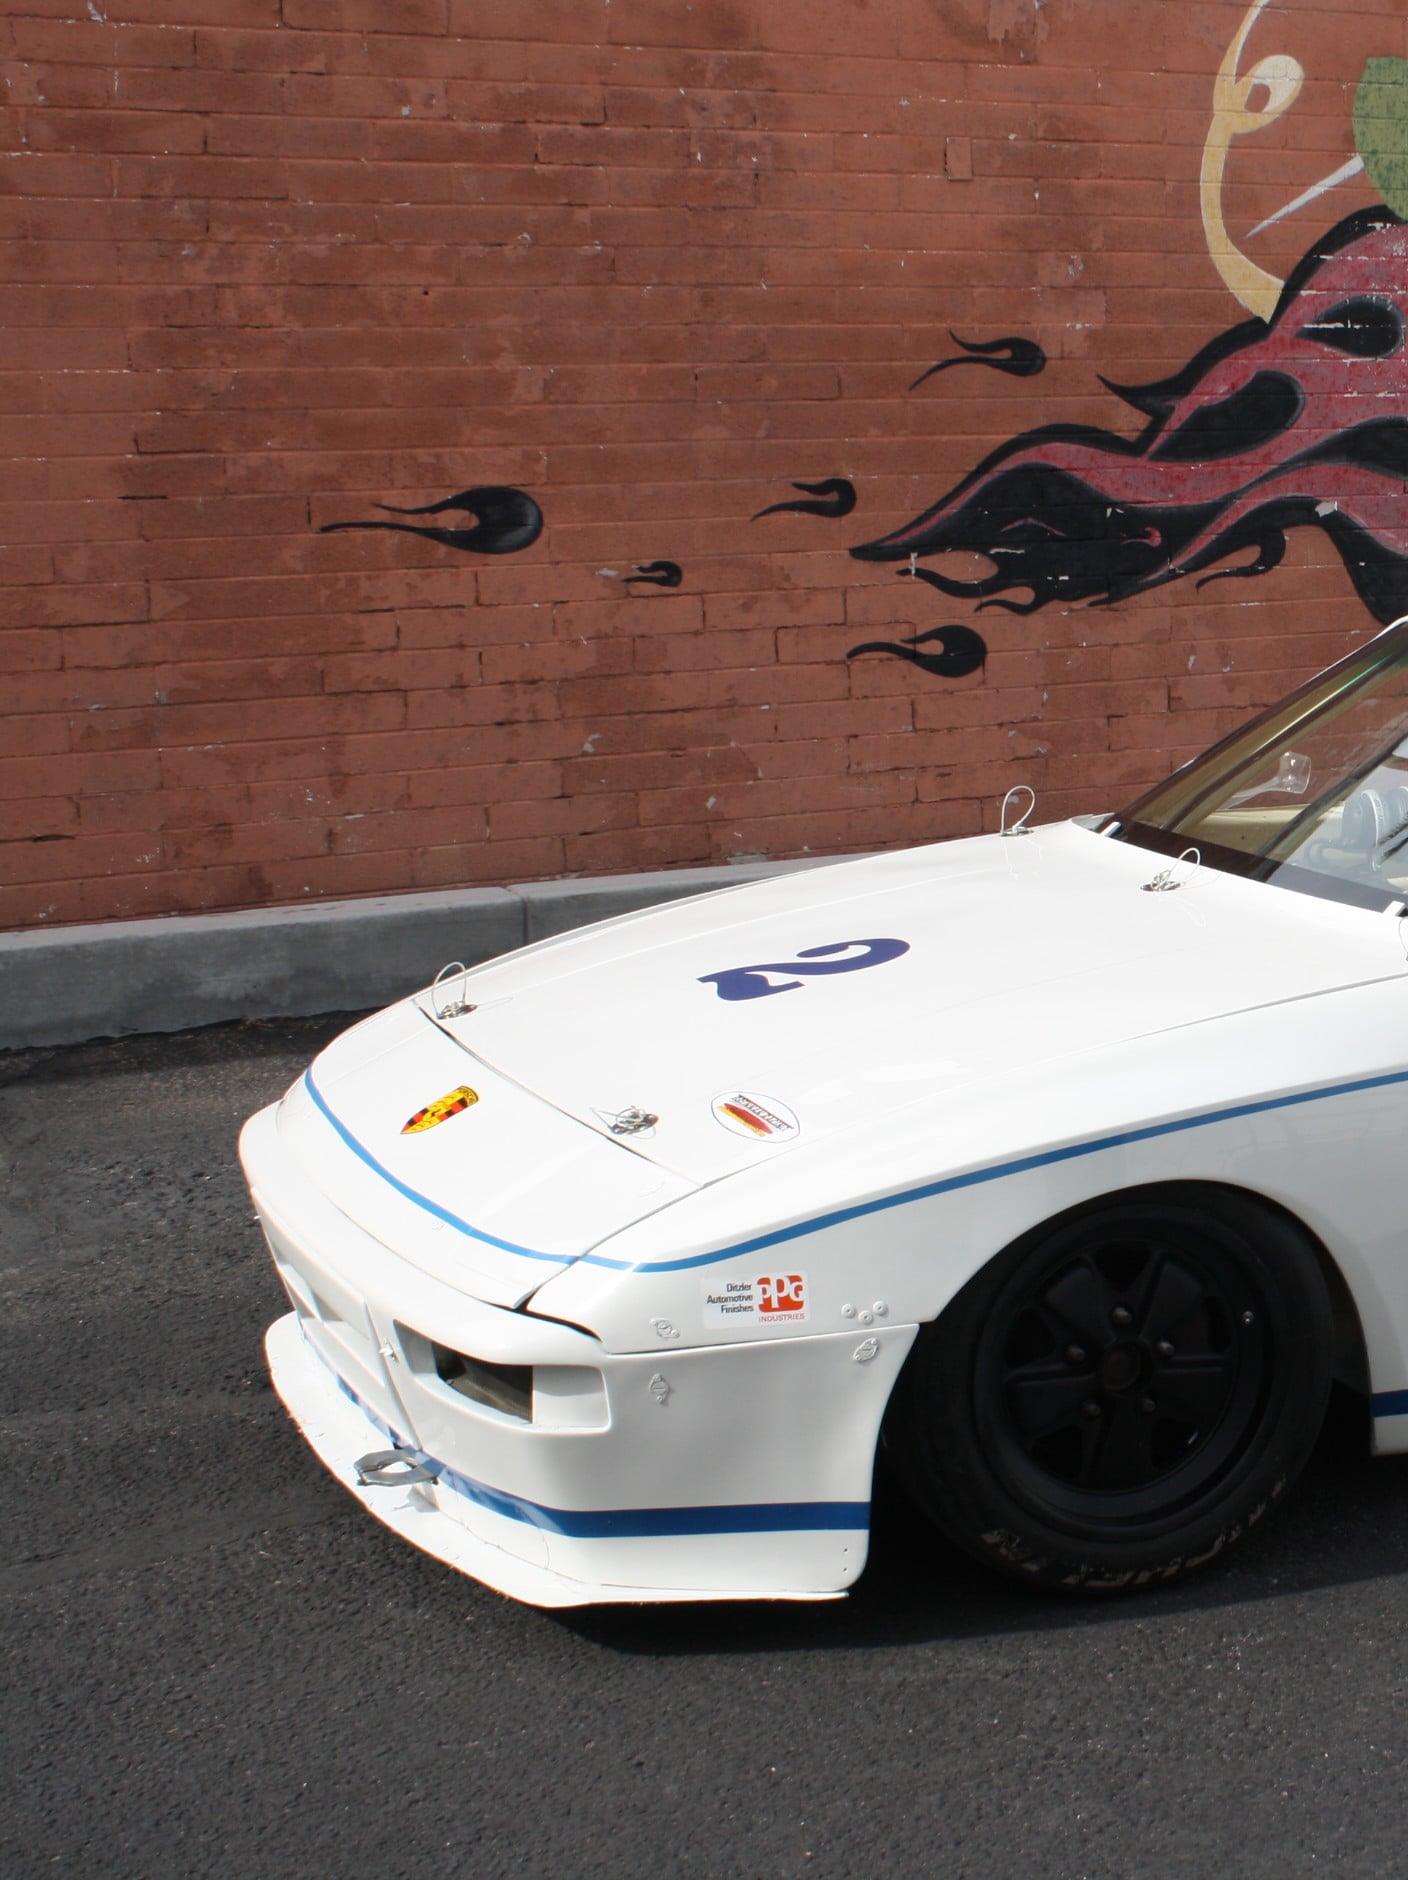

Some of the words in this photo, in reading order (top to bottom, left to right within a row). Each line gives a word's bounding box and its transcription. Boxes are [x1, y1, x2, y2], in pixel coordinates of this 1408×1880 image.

[695, 938, 911, 1002] 2
[726, 1282, 752, 1293] Ditzler
[706, 1292, 754, 1304] Automotive
[720, 1304, 754, 1314] Finishes
[758, 1312, 805, 1323] INDUSTRIES
